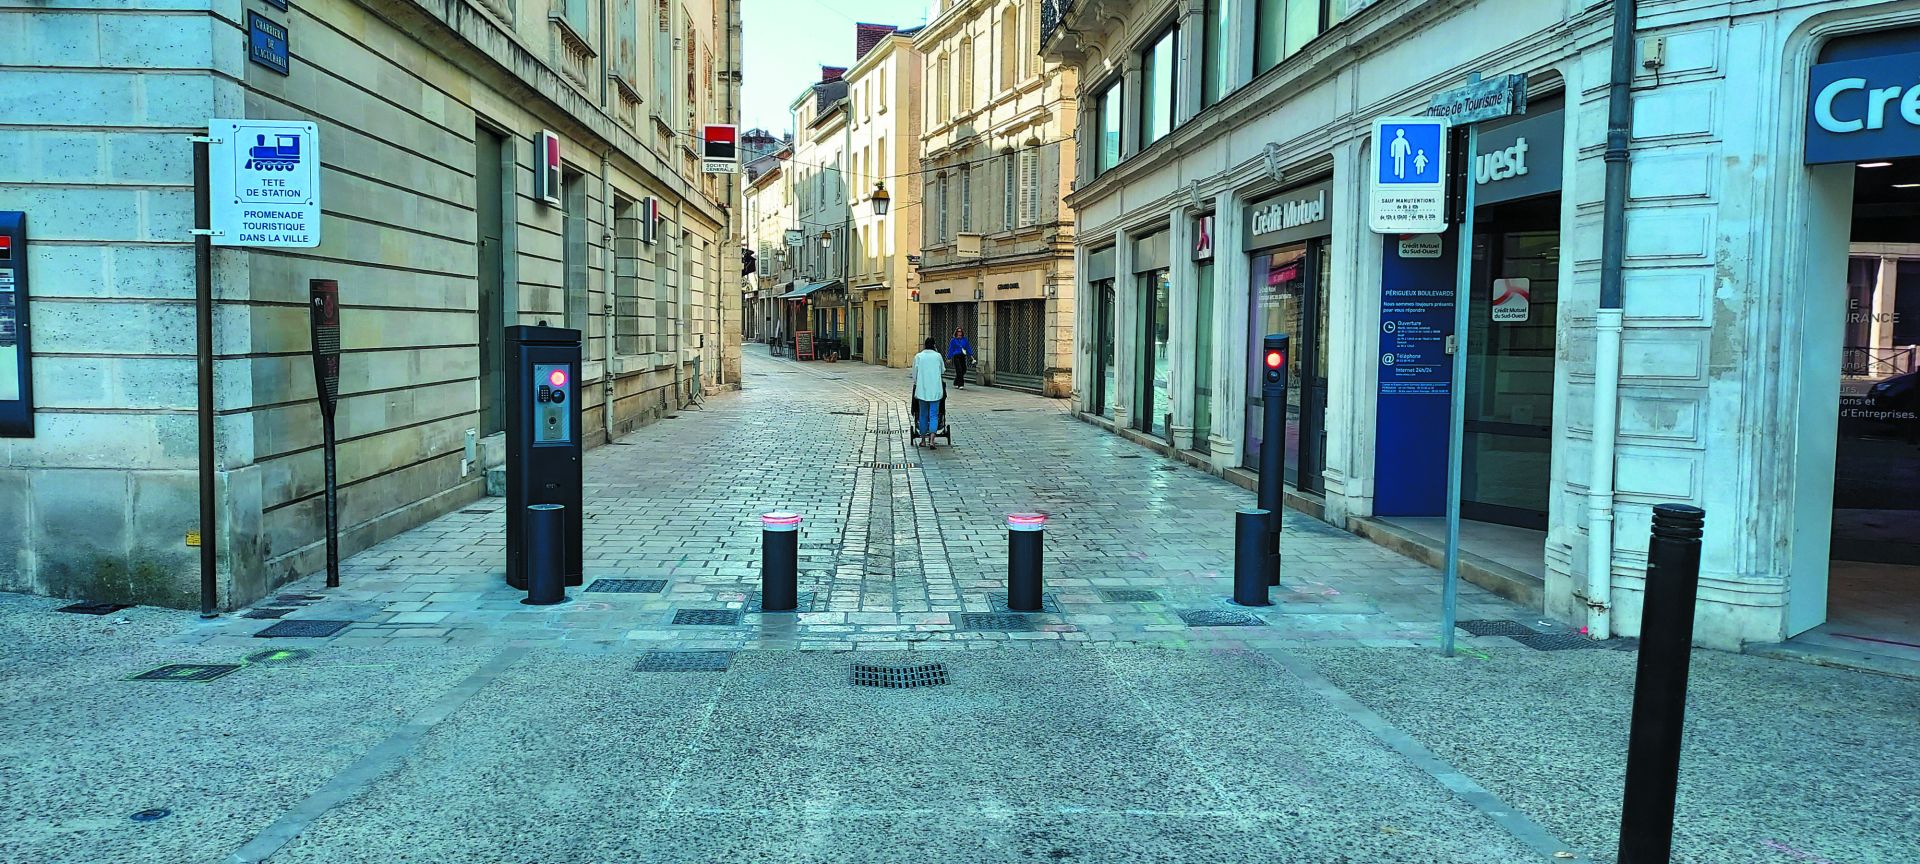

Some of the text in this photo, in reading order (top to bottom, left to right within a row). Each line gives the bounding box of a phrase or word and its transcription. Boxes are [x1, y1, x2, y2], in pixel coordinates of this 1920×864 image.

[1426, 91, 1503, 117] Office de Tourisme
[1475, 137, 1529, 185] uest
[261, 178, 285, 187] TETE
[246, 188, 301, 198] DE STATION
[243, 210, 304, 219] PROMENADE
[1251, 188, 1327, 236] Crédit Mutuel
[242, 222, 306, 231] TOURISTIQUE
[239, 233, 309, 243] DANS LA VILLE
[1864, 398, 1876, 406] et
[1840, 408, 1918, 420] d'Entreprises.
